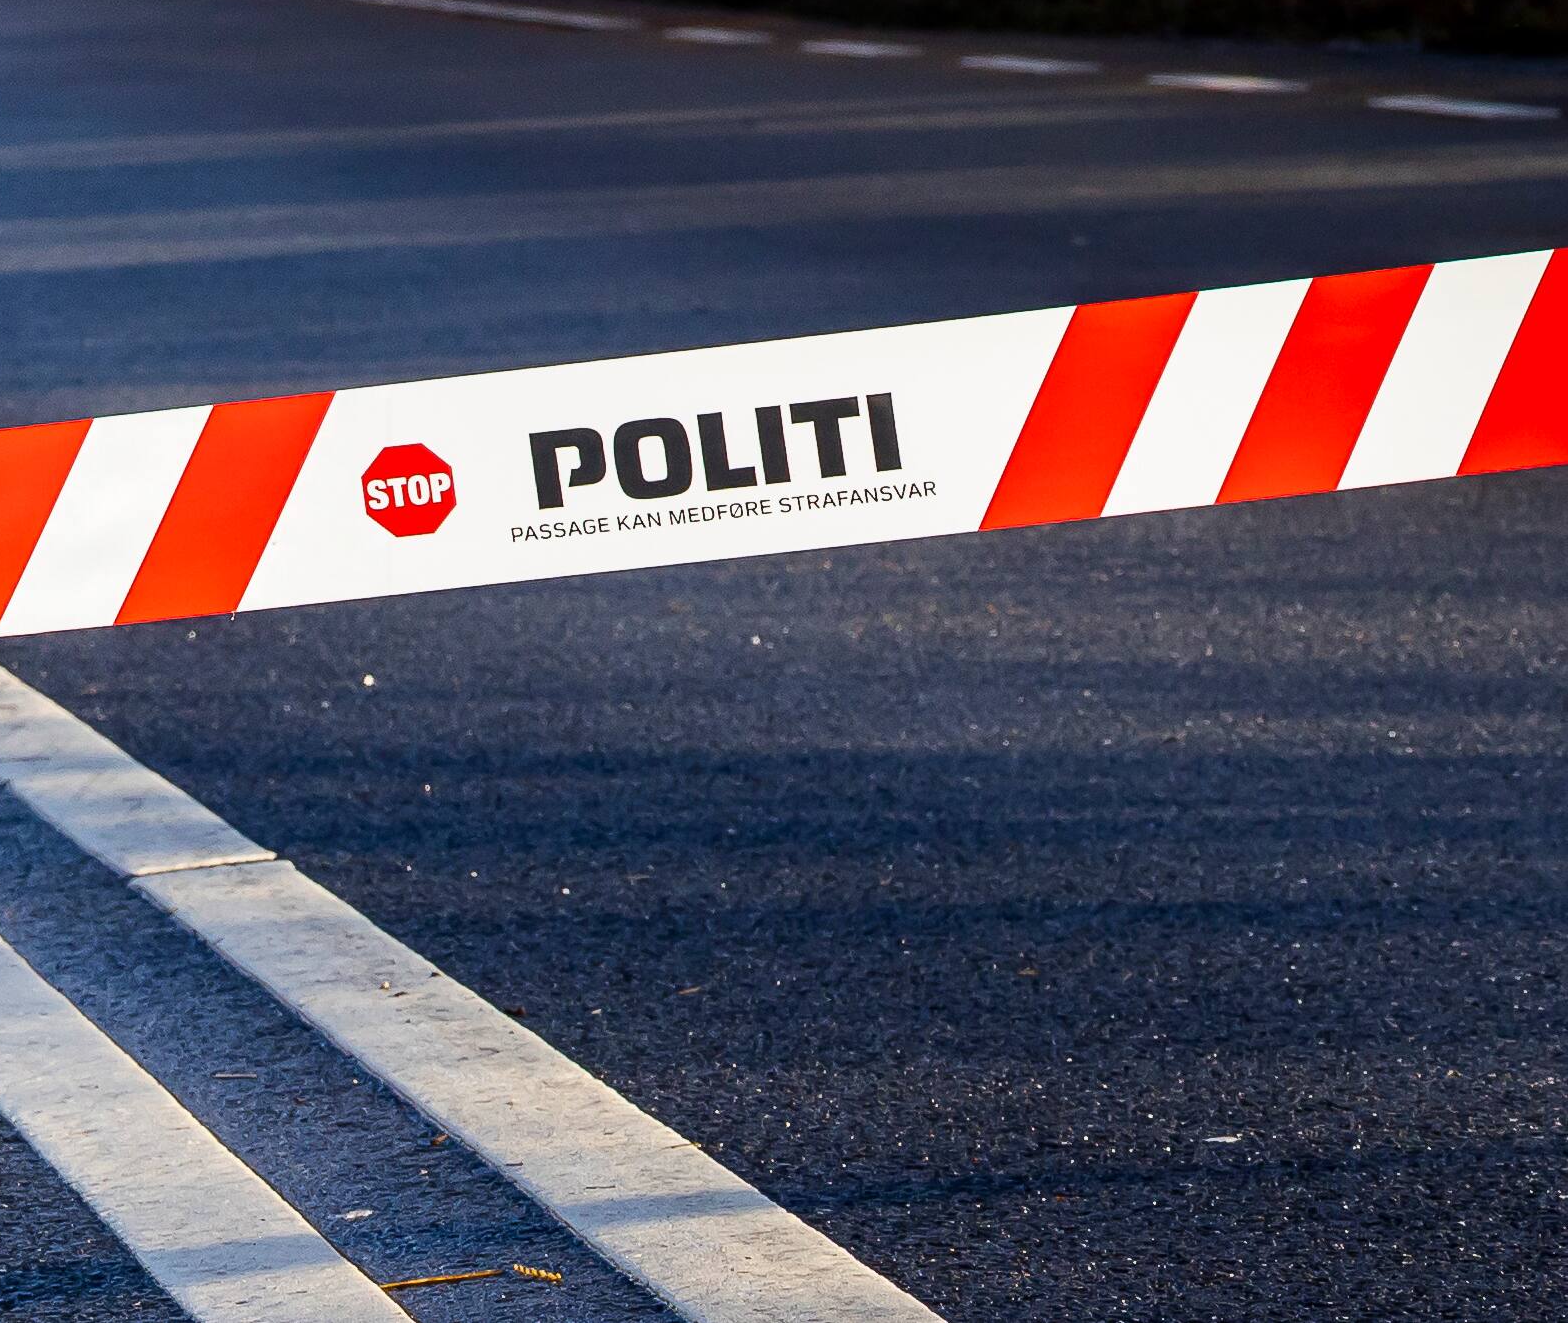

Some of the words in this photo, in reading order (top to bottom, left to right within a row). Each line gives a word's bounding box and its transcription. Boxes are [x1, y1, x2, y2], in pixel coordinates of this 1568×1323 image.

[528, 391, 903, 511] POLITI
[366, 472, 451, 510] STOP
[510, 517, 611, 543] PASSAGE
[616, 511, 662, 531] KAN
[668, 499, 773, 526] MEDFØRE
[778, 481, 937, 513] STRAFANSVAR
